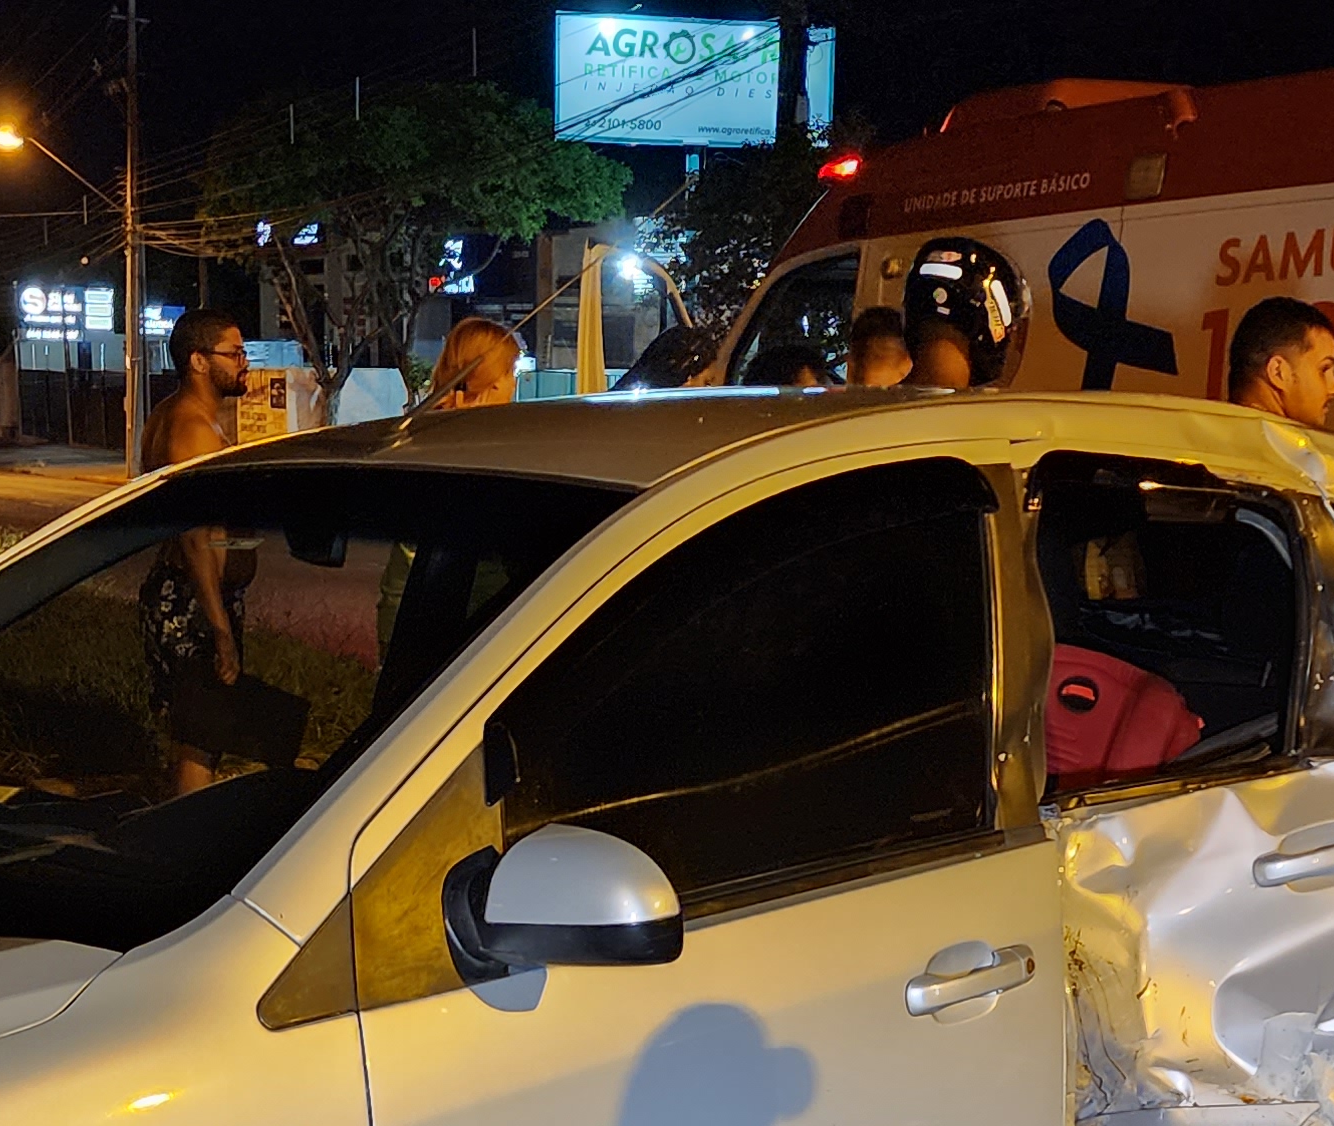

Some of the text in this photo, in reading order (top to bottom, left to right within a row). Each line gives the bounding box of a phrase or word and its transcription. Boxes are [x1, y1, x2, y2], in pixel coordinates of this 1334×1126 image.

[584, 63, 670, 80] RETIFICA
[903, 171, 1092, 214] UNIDADE DE SUPORTE BÁSICO
